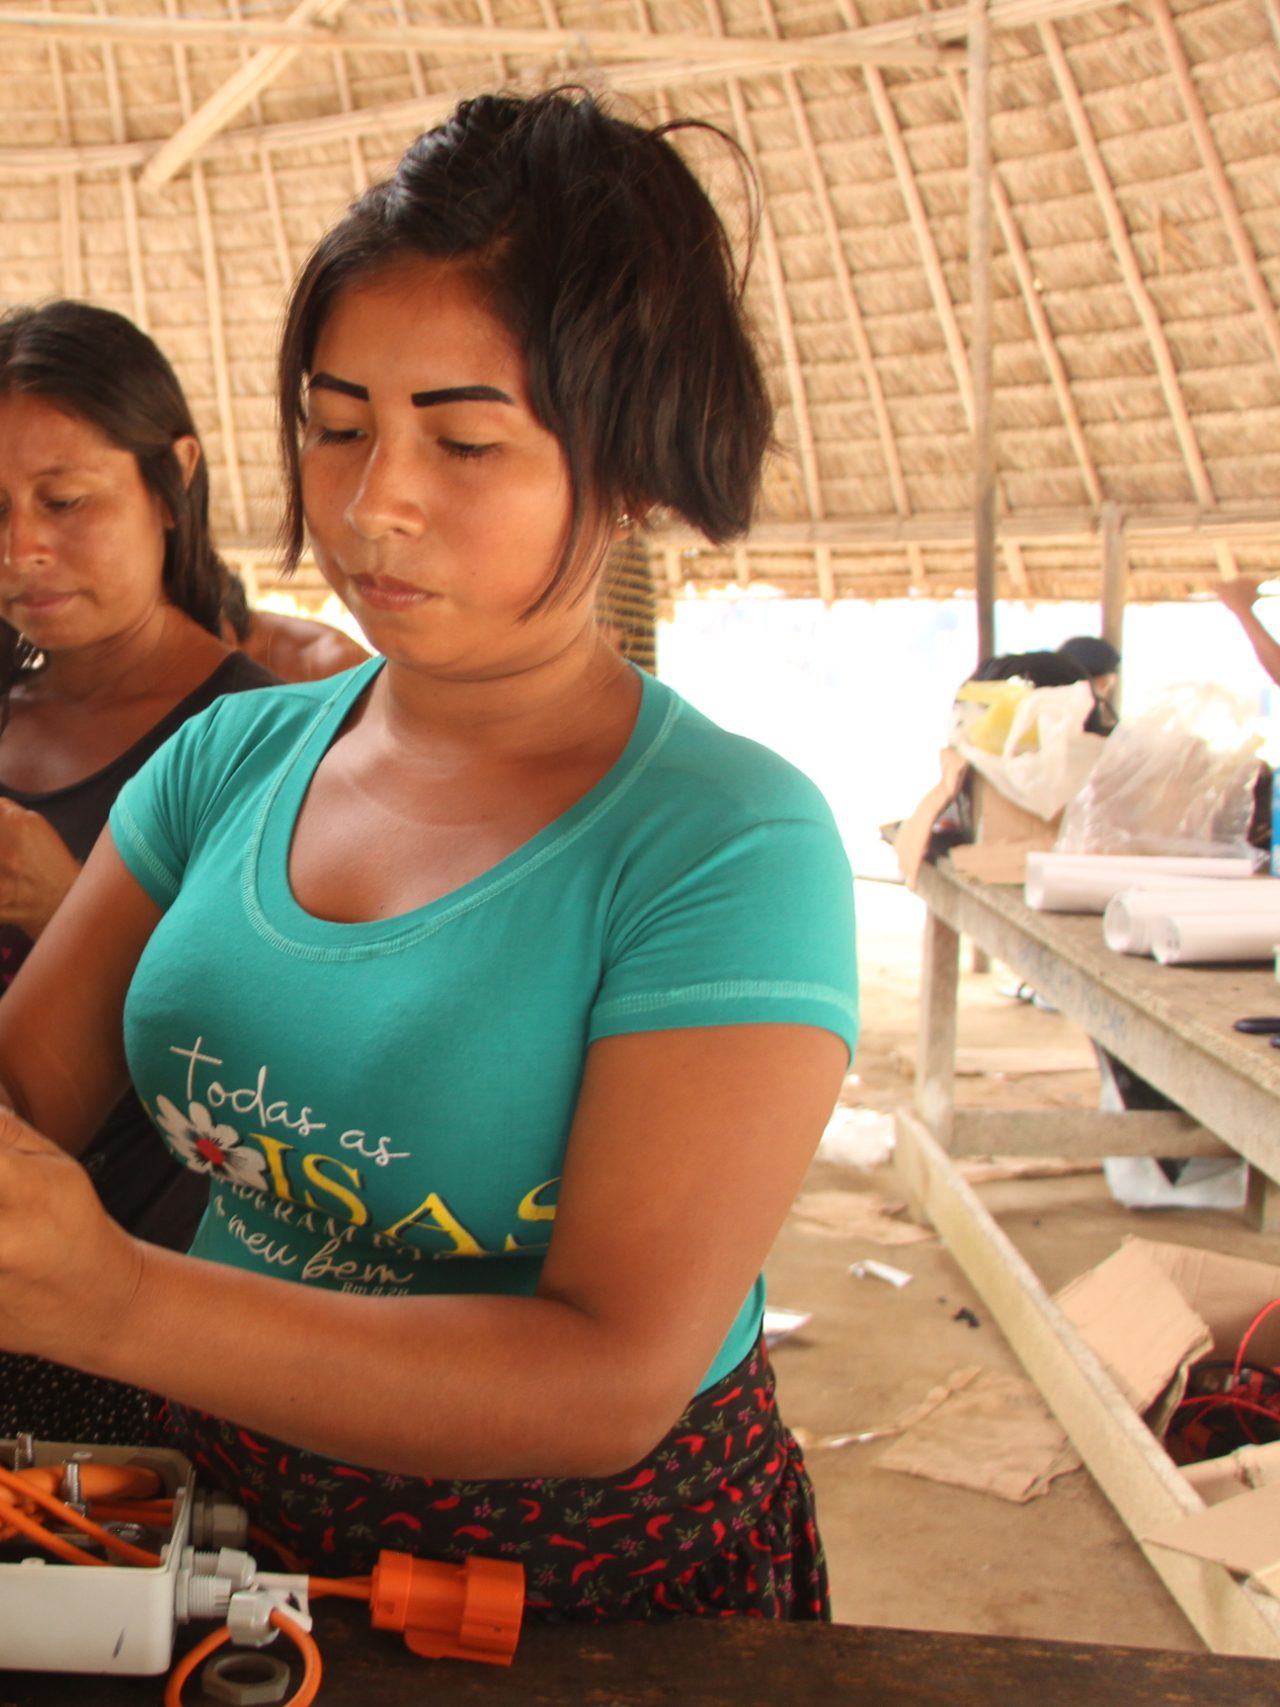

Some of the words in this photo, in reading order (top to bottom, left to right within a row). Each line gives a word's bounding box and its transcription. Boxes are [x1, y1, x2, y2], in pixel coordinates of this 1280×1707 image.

[340, 1130, 411, 1167] as
[228, 1214, 298, 1266] meu
[302, 1235, 415, 1284] bem
